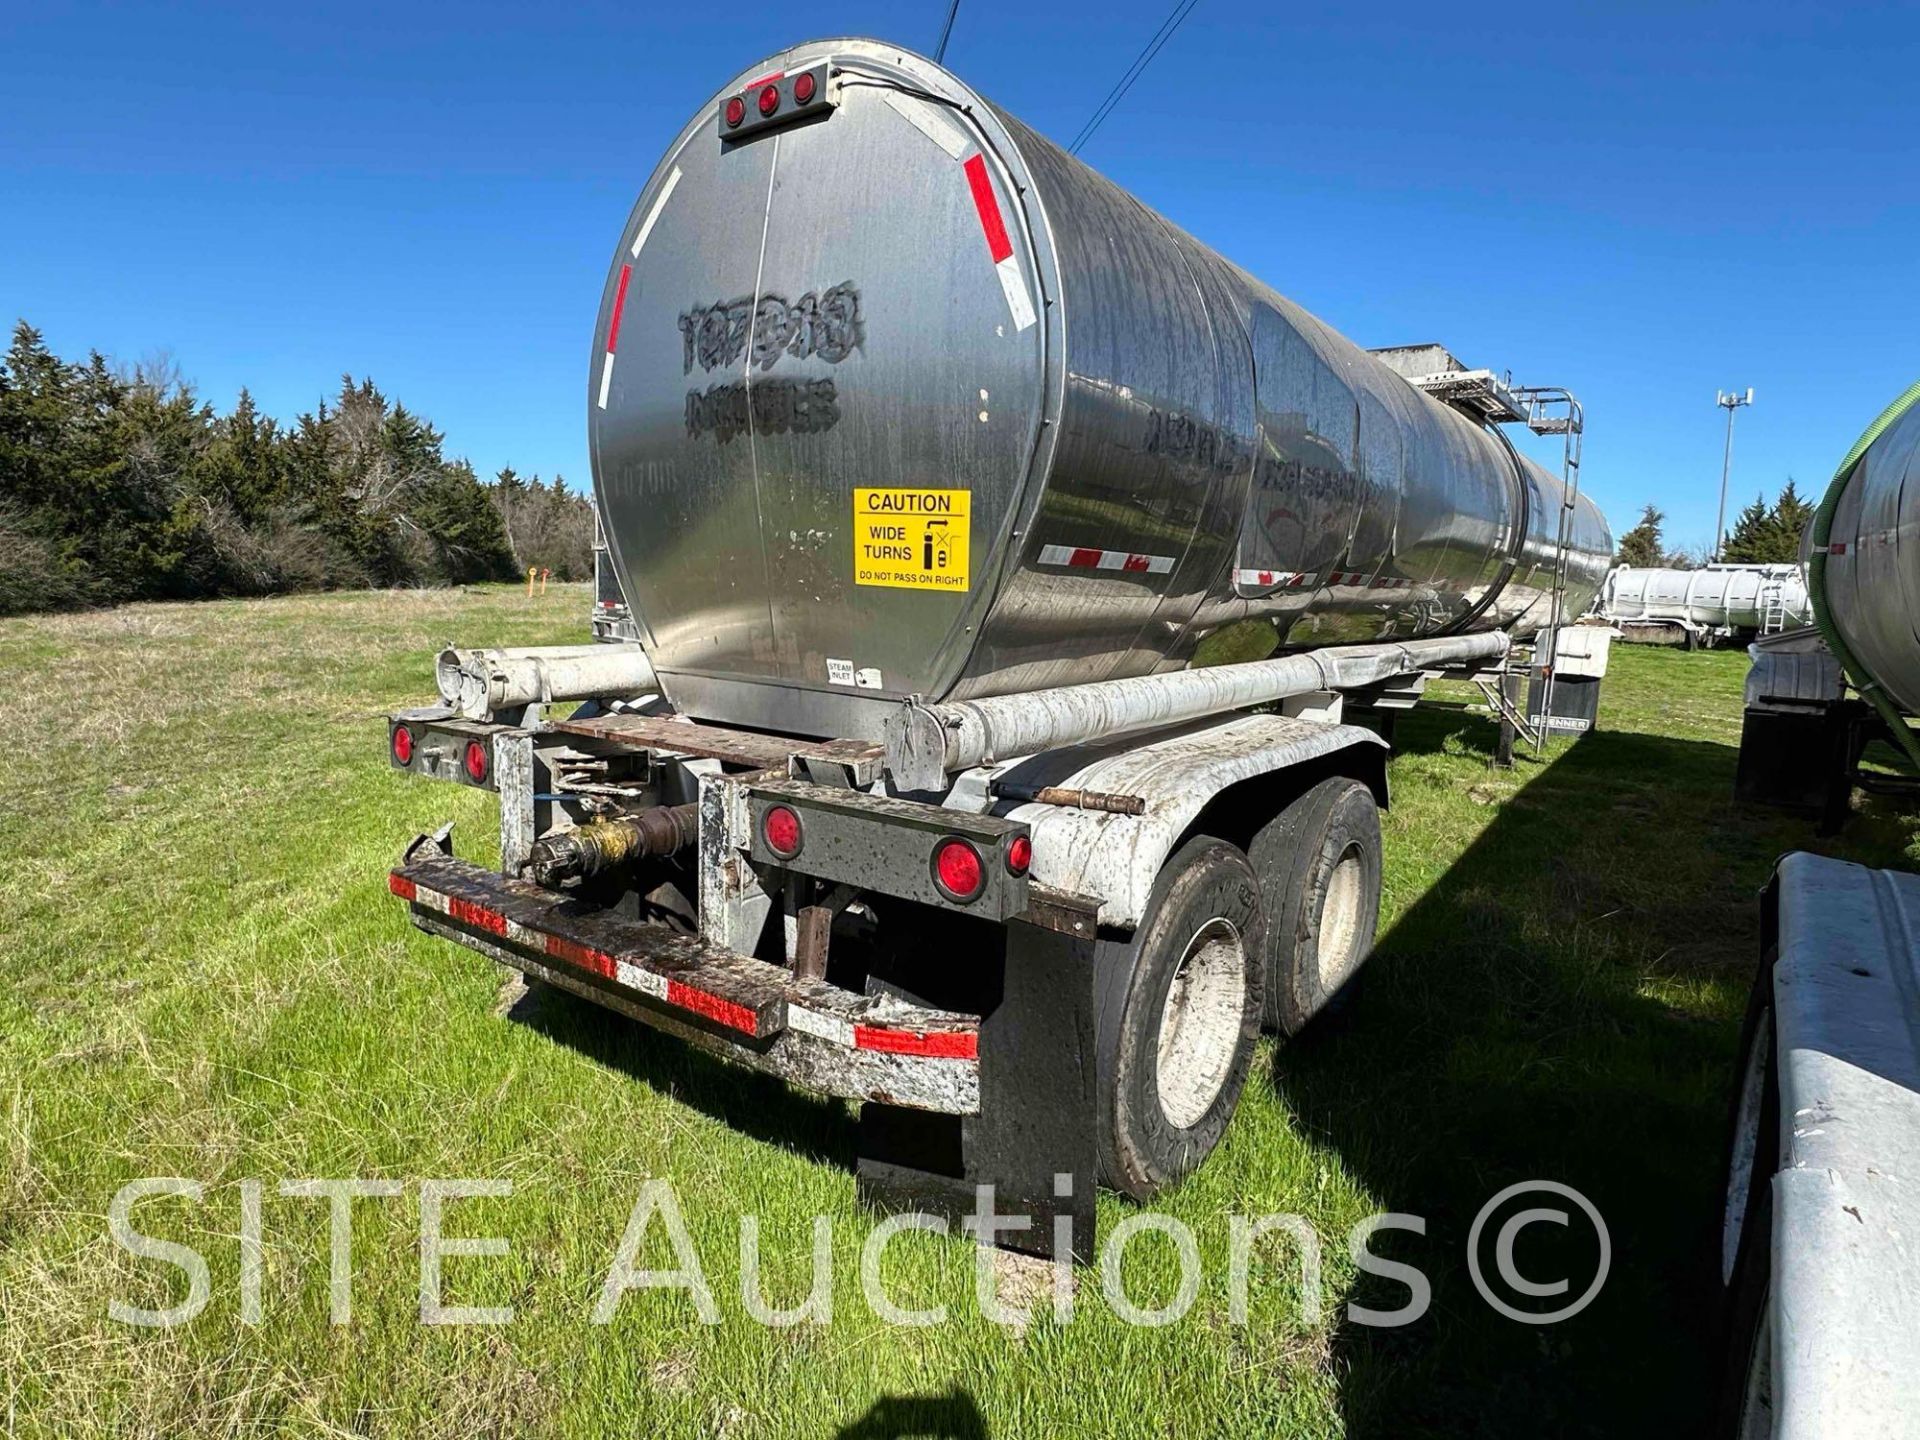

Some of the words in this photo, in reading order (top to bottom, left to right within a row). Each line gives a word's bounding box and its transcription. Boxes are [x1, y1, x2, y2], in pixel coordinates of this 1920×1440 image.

[868, 493, 951, 512] CAUTION
[869, 526, 906, 540] WIDE
[864, 544, 912, 560] TURNS
[860, 570, 872, 579] DO
[874, 572, 892, 580] NOT
[894, 573, 917, 583] PASS
[919, 575, 933, 583] ON
[935, 576, 965, 586] RIGHT
[829, 663, 852, 671] STEAM
[832, 671, 850, 680] INLET
